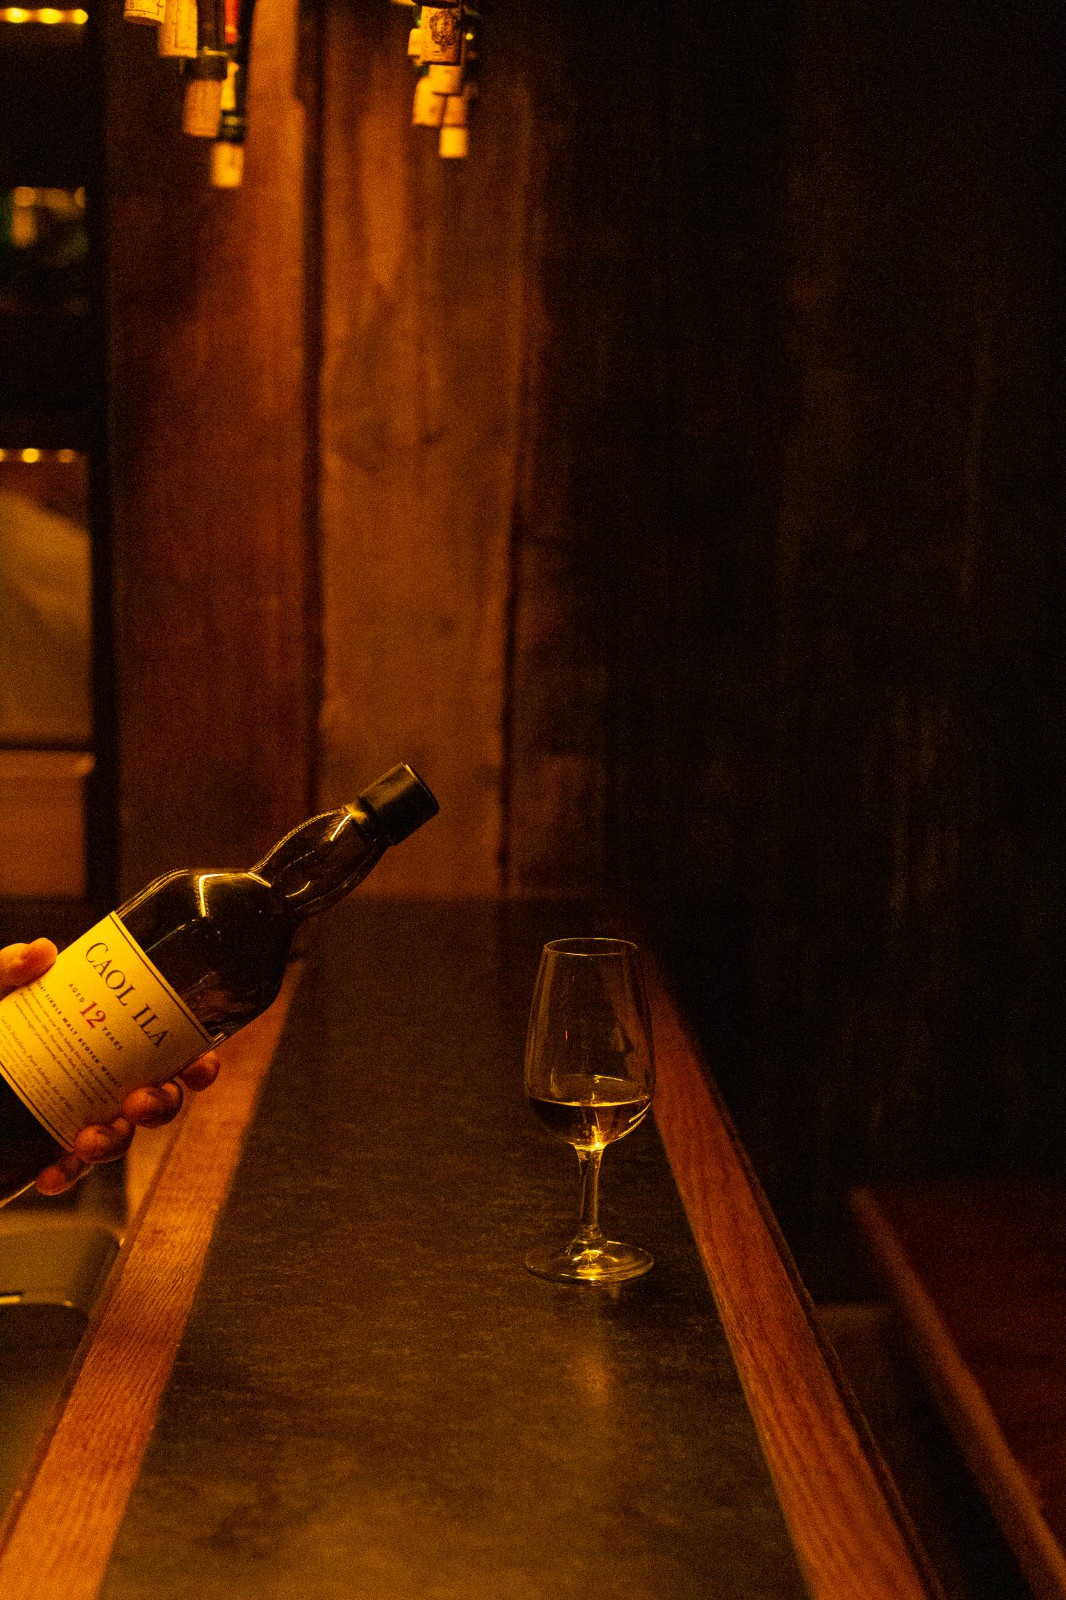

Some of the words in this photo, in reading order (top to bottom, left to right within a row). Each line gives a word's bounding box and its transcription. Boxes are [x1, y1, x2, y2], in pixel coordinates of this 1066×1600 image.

[44, 993, 62, 1015] SINGLE
[62, 1017, 77, 1034] MALT
[78, 1038, 99, 1063] SCOTCH
[68, 983, 84, 1002] AGED
[79, 1001, 106, 1029] 12
[102, 1026, 122, 1050] YEARS
[86, 942, 136, 1007] CAOL
[131, 1004, 170, 1047] ILA
